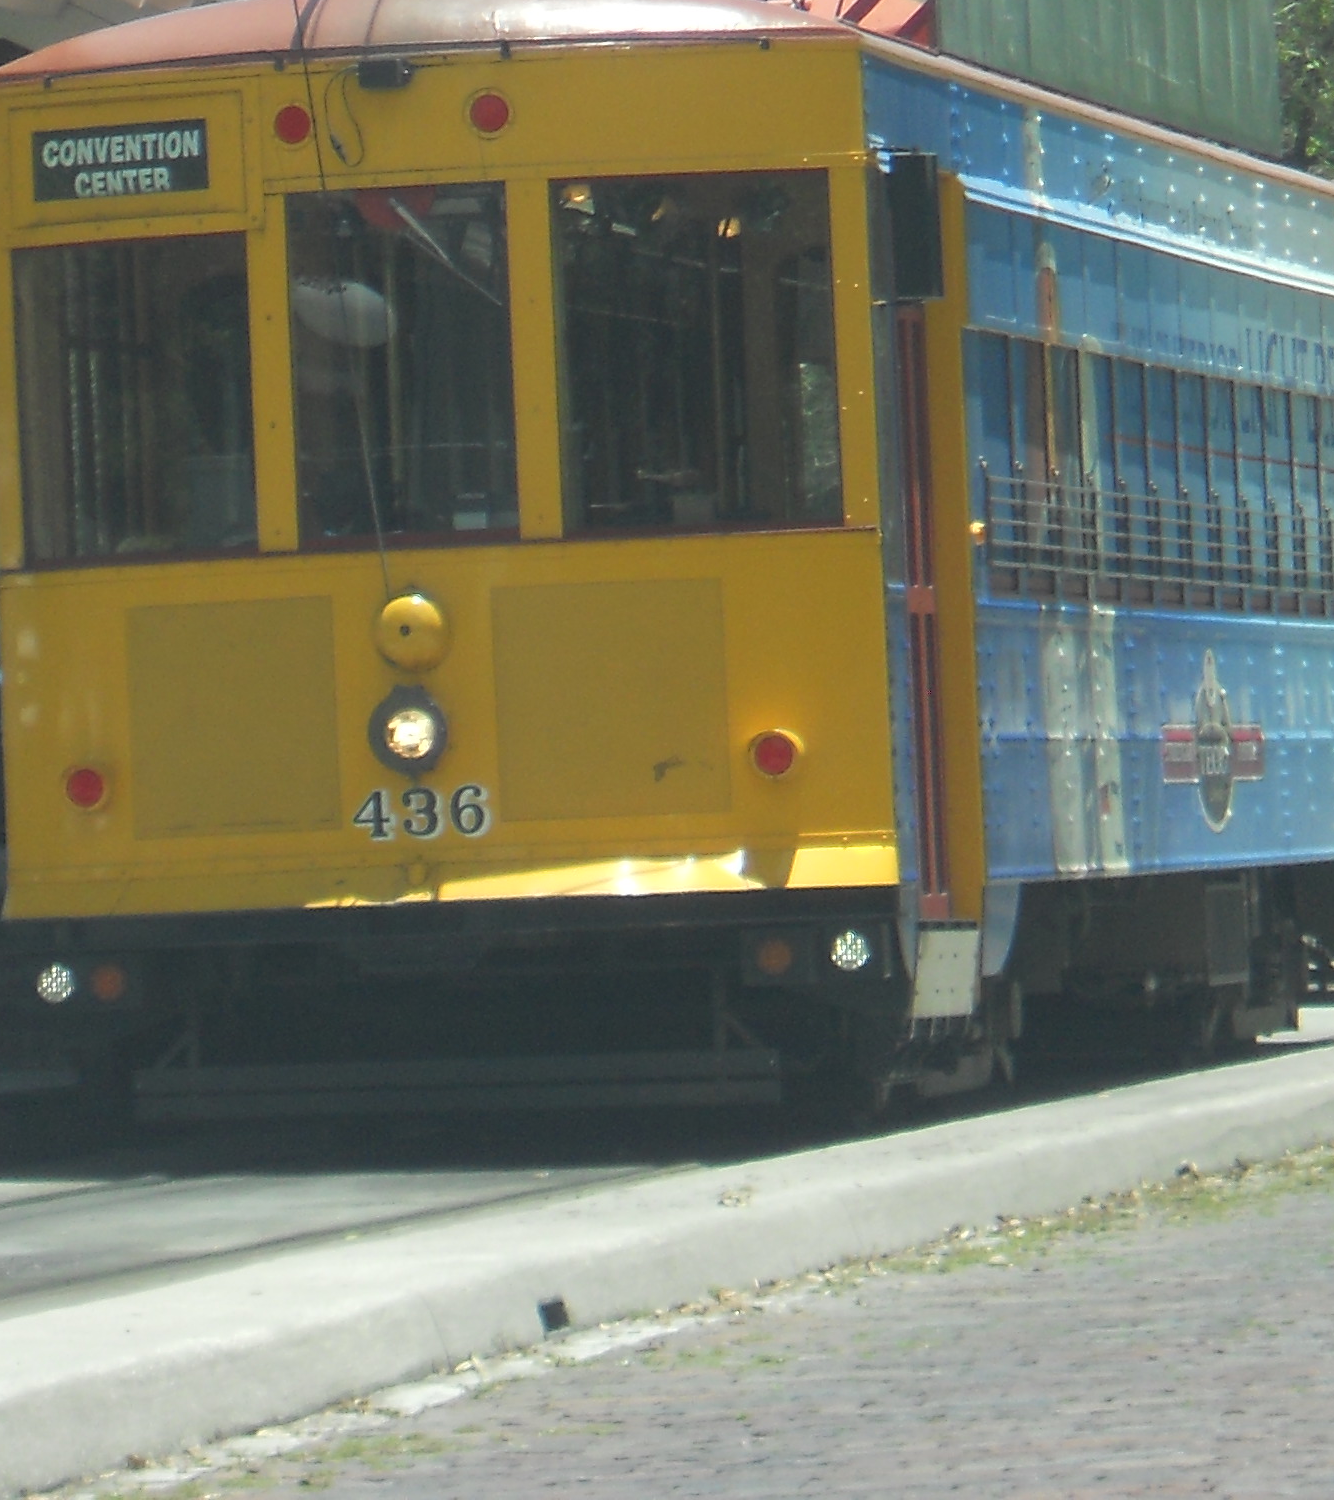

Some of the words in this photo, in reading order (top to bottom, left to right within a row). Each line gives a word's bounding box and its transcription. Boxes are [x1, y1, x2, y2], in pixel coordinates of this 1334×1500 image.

[40, 128, 200, 168] CONVENTION
[73, 166, 171, 198] CENTER
[353, 783, 492, 841] 436
